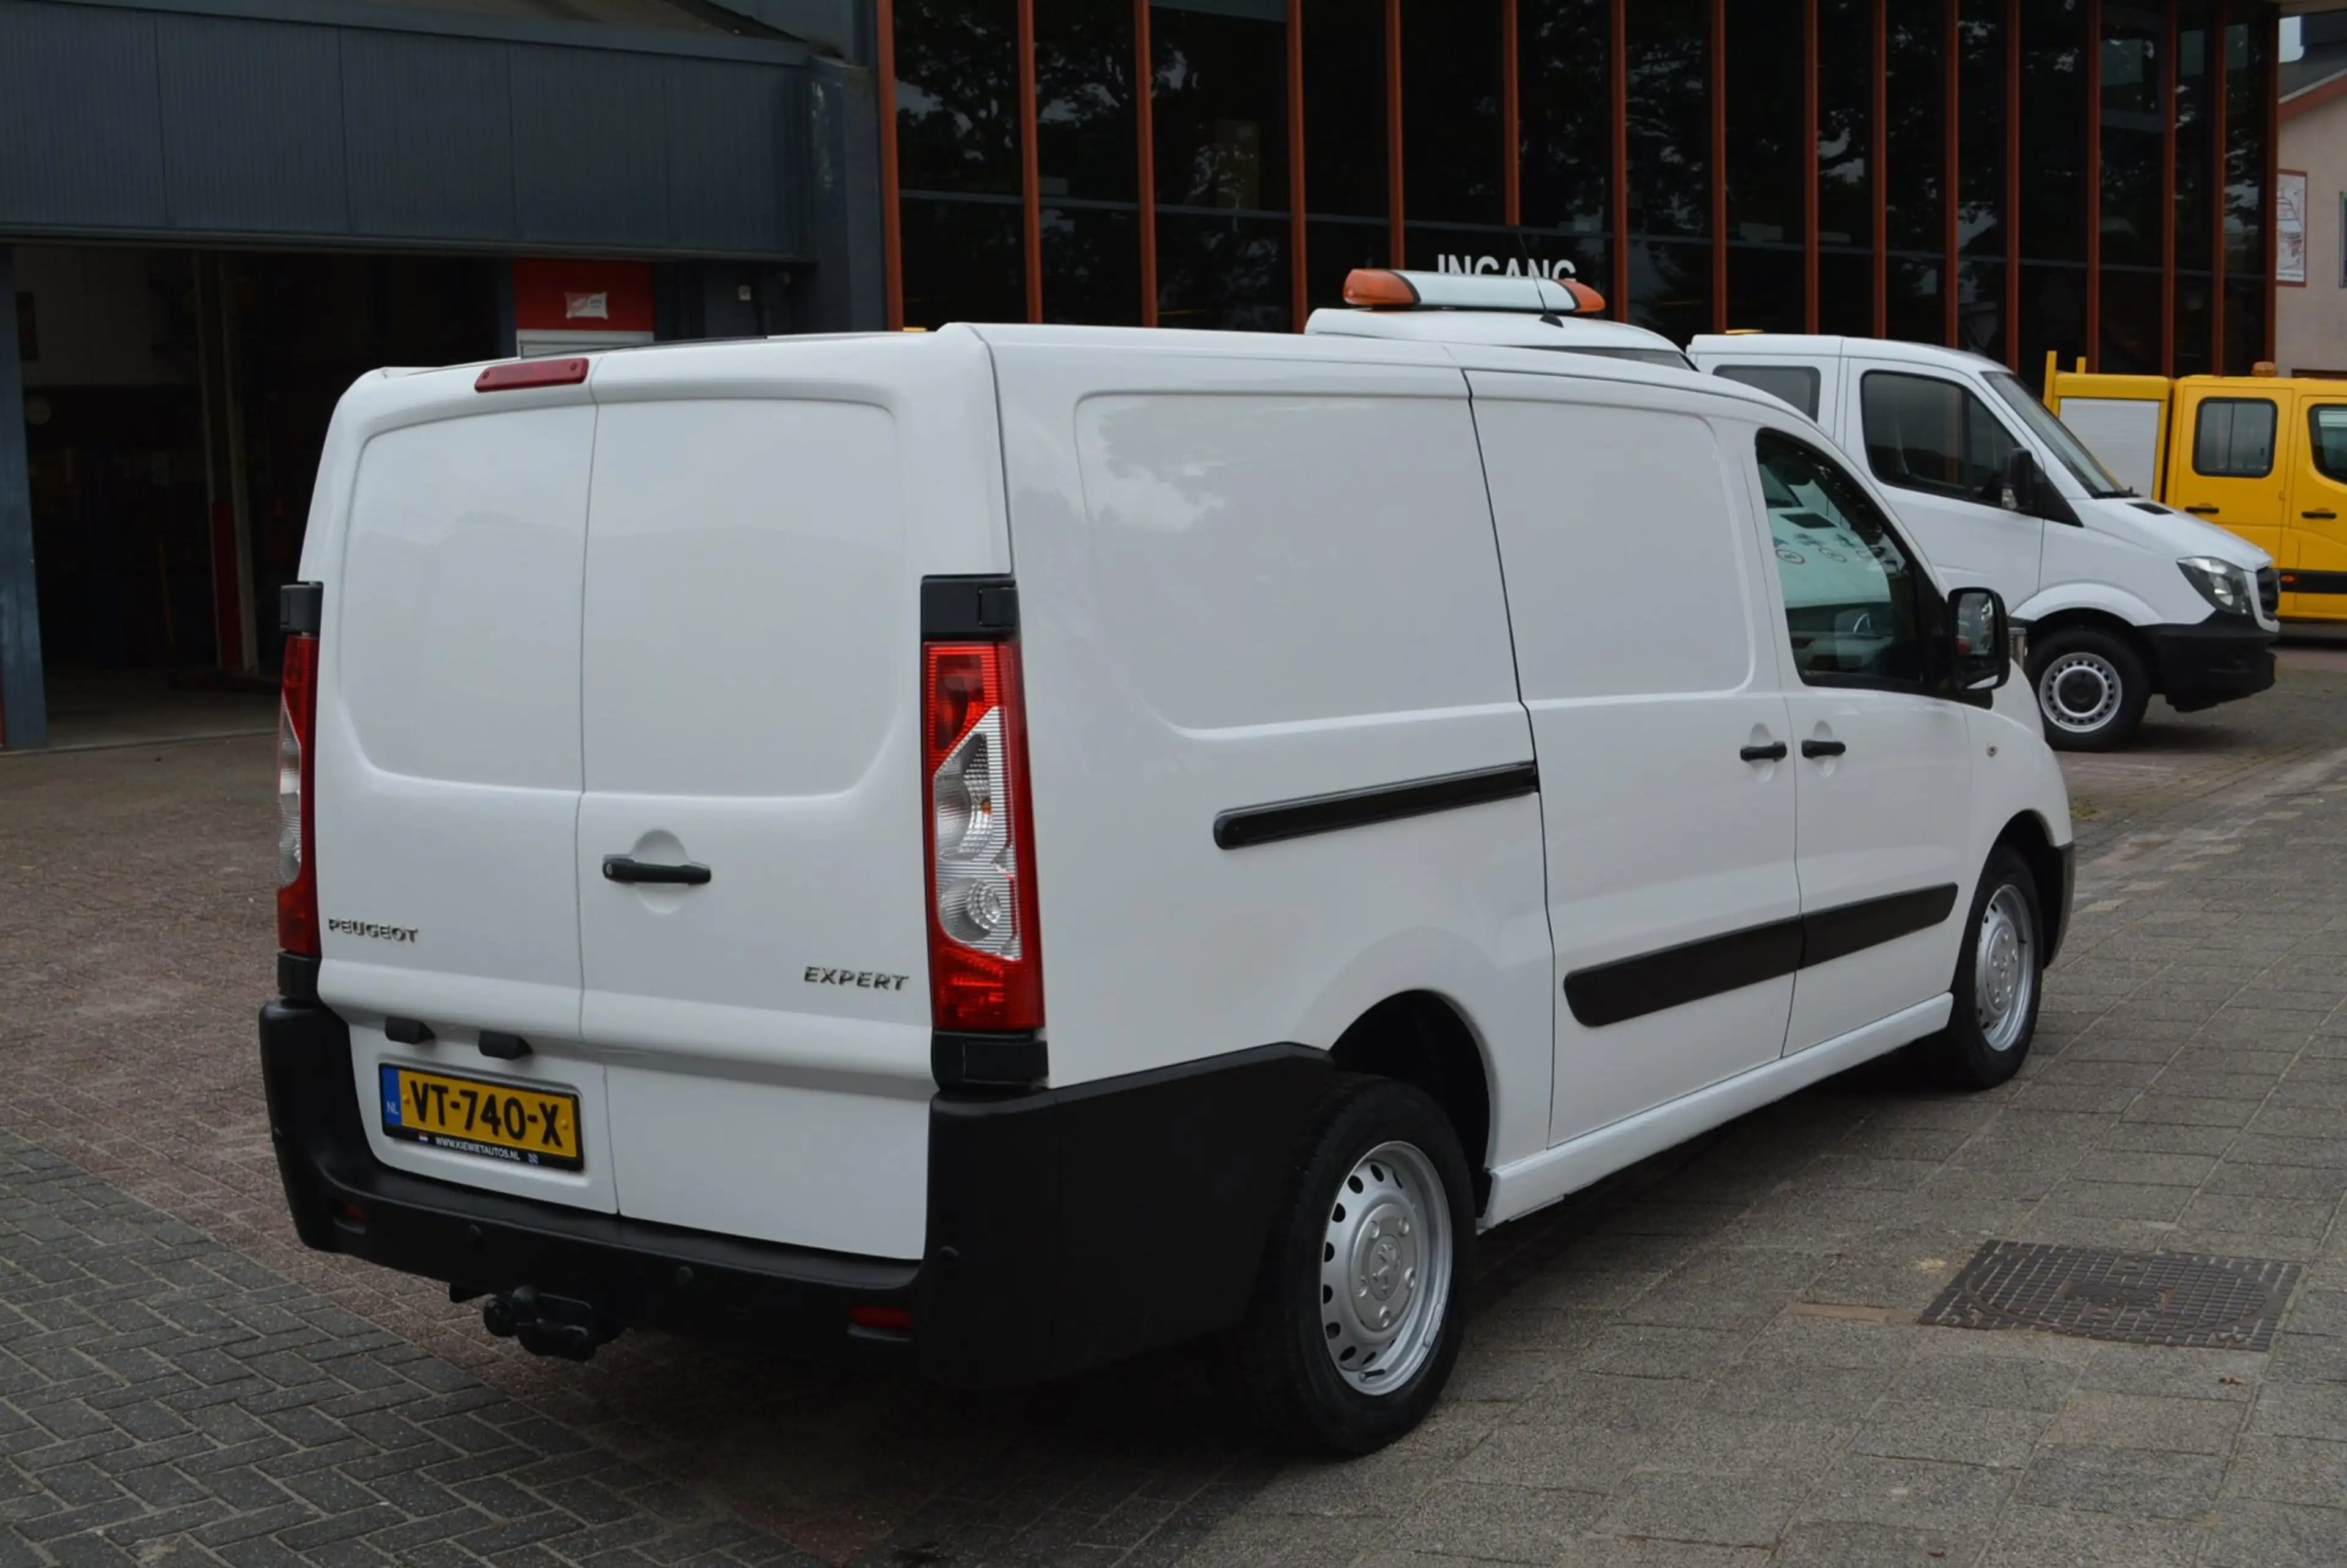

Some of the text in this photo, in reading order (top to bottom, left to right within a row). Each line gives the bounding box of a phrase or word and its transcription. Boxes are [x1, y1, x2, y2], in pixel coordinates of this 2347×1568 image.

[328, 918, 418, 943] PEUGEOT
[804, 966, 909, 991] EXPERT
[386, 1101, 399, 1115] NL
[409, 1080, 564, 1148] VT-740-X
